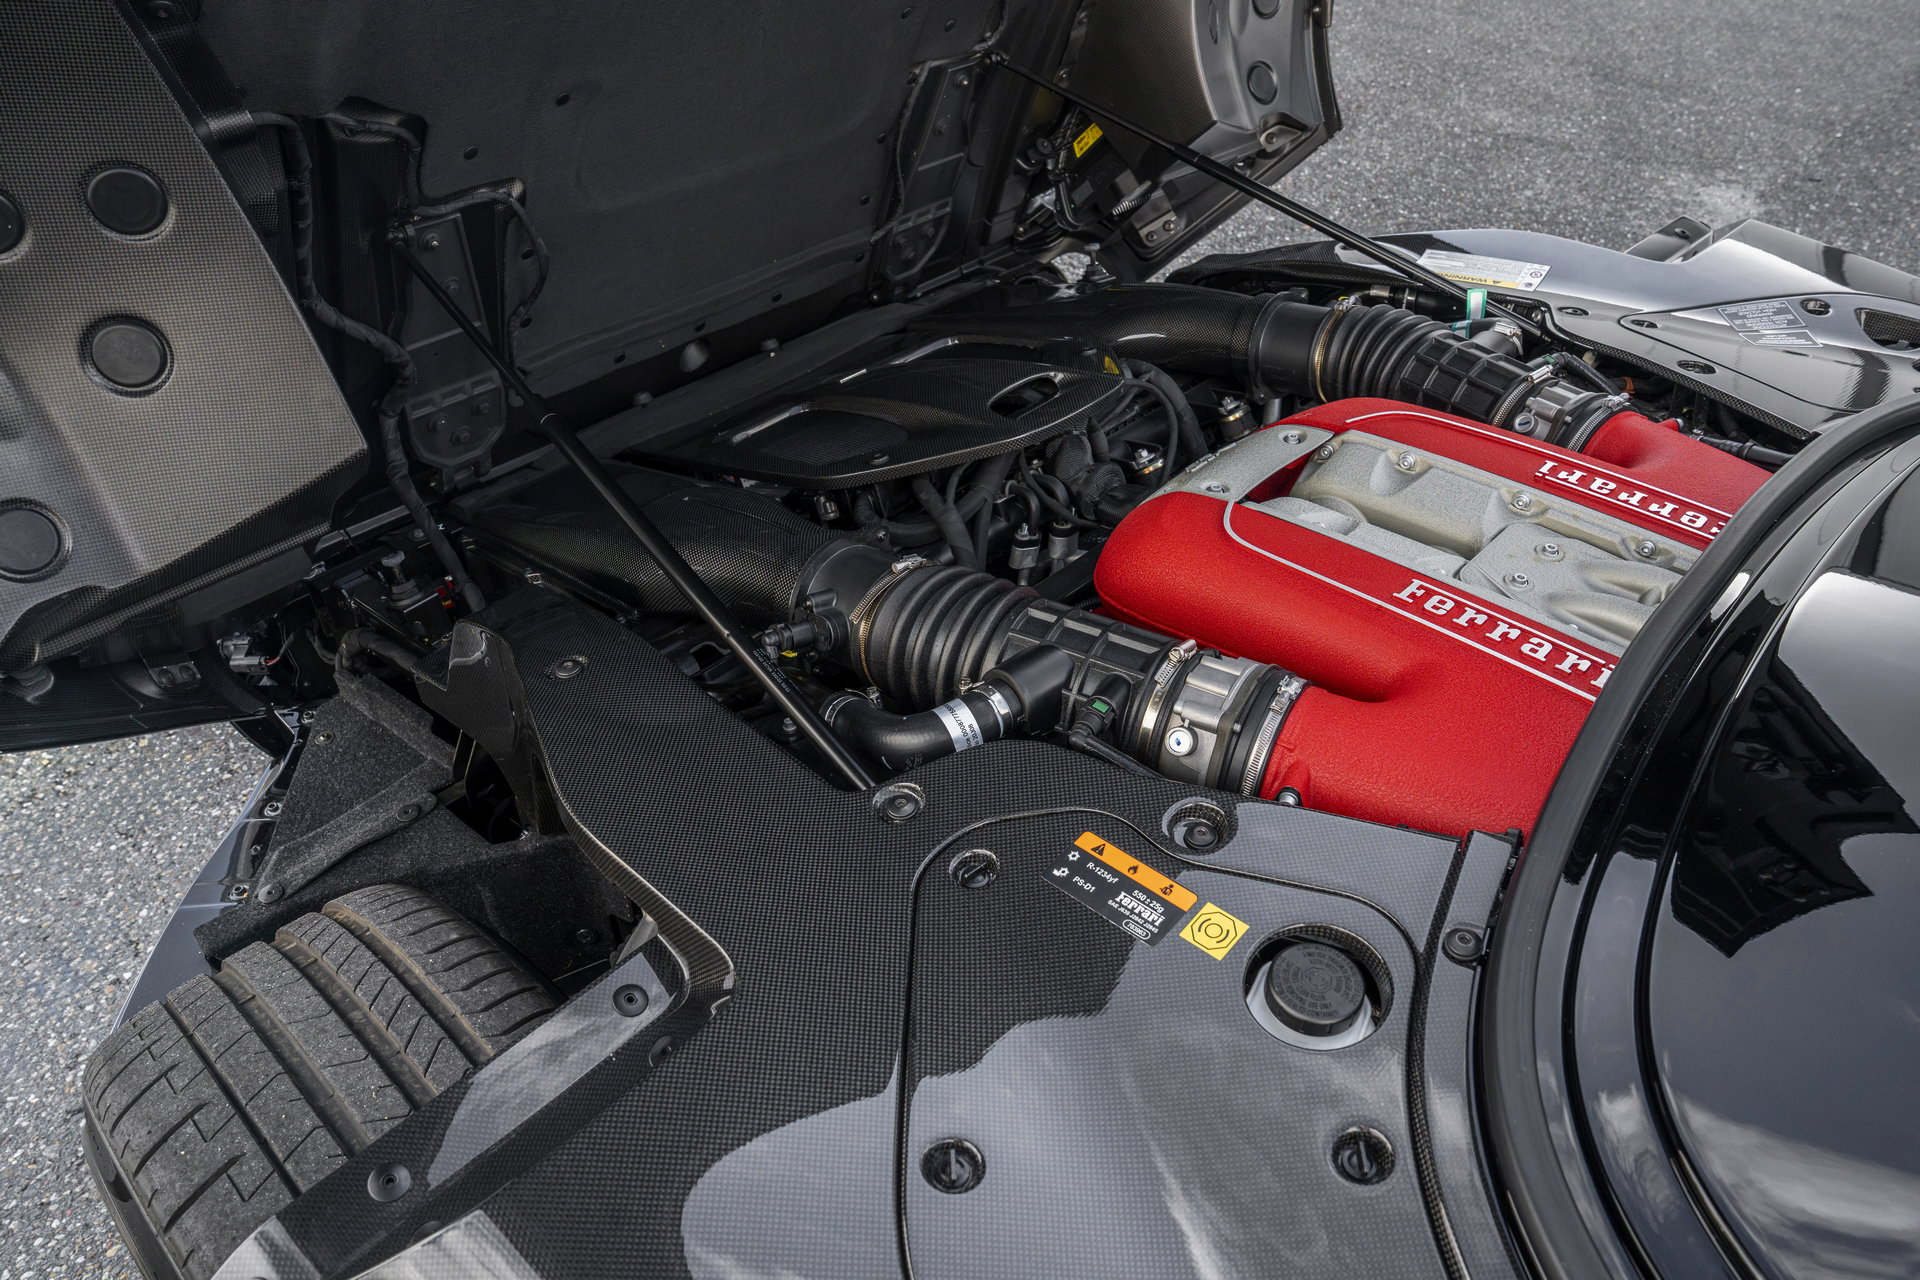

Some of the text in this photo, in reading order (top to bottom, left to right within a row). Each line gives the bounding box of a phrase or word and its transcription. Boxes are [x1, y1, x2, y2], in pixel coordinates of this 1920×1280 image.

[1392, 578, 1616, 688] Ferrari
[1072, 876, 1096, 892] PS-D1
[1086, 862, 1119, 883] R-1234yf
[1115, 891, 1165, 926] Ferrari
